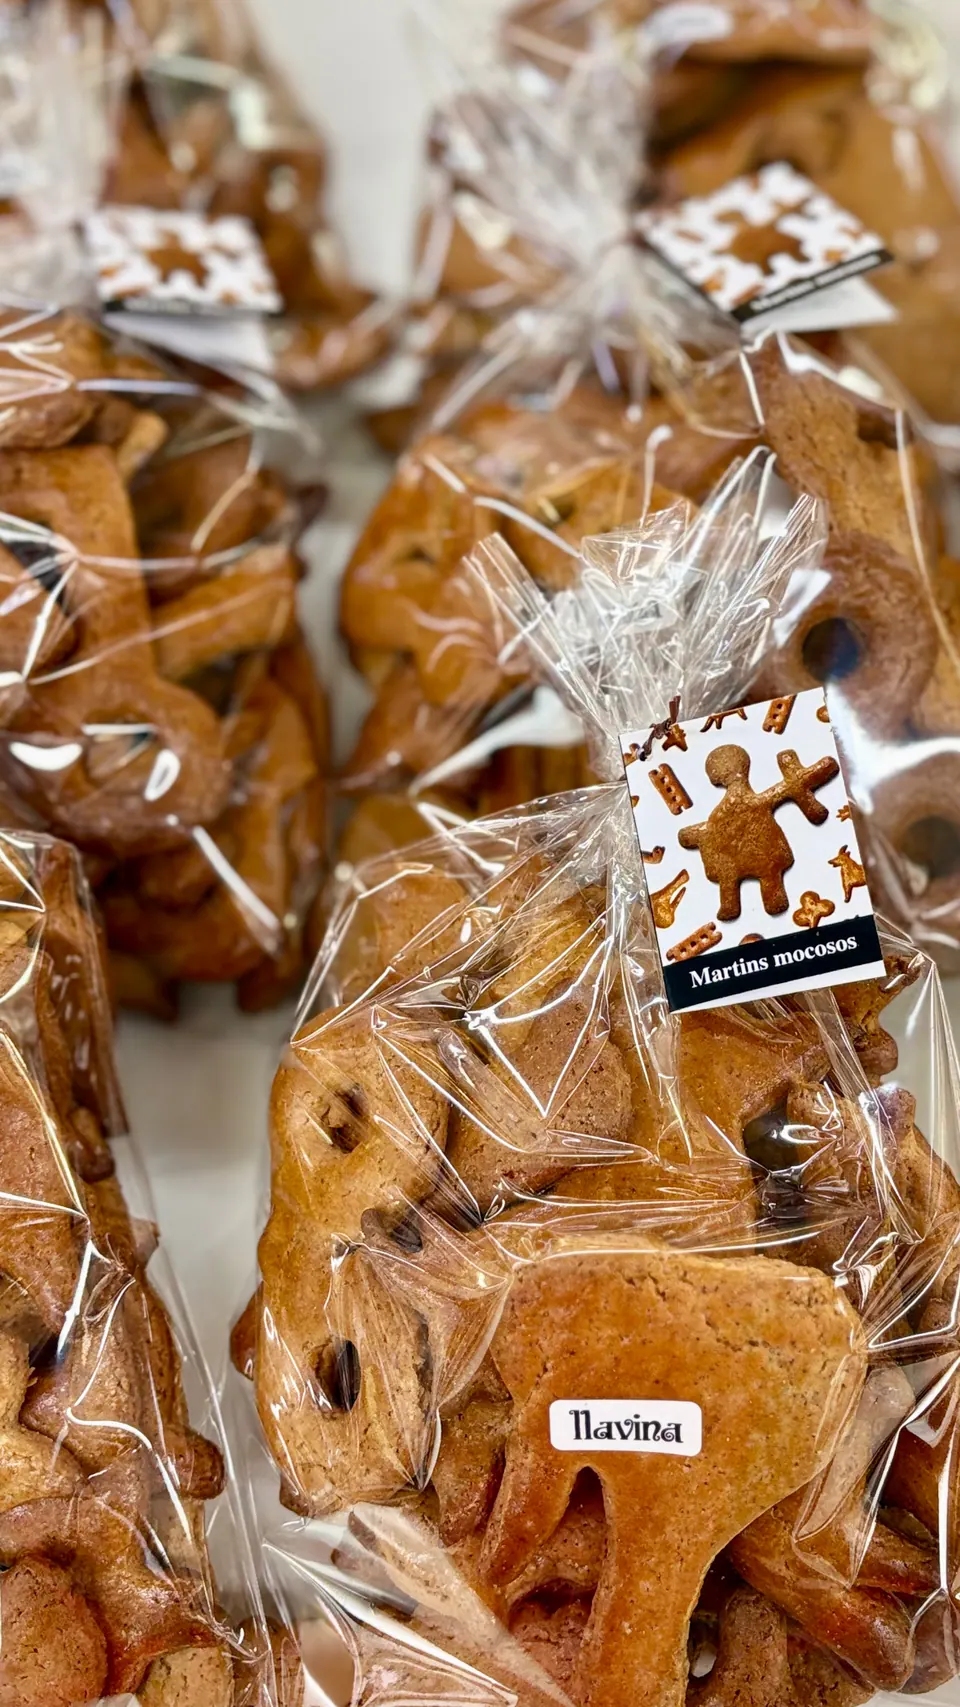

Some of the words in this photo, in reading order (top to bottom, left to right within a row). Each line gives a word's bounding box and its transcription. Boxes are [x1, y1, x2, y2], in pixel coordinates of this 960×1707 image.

[689, 953, 769, 989] Martins
[774, 935, 858, 968] mocosos
[568, 1409, 684, 1443] llavina
